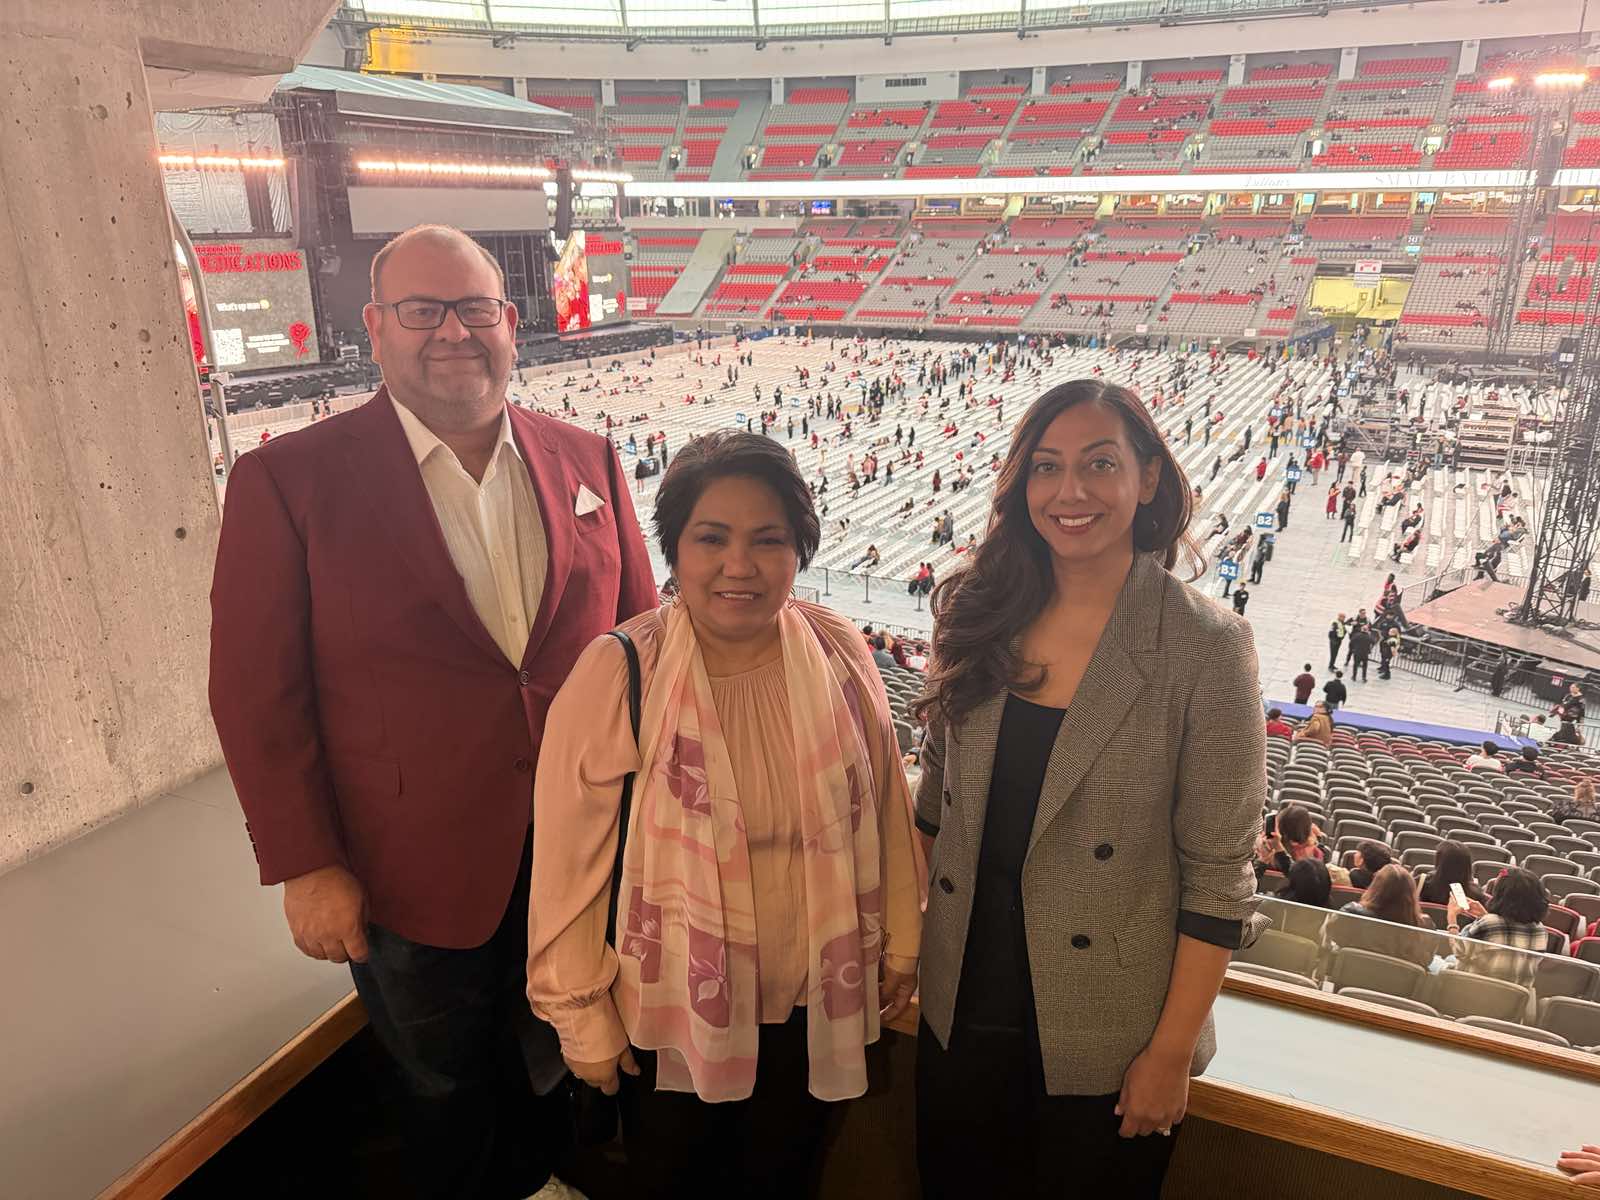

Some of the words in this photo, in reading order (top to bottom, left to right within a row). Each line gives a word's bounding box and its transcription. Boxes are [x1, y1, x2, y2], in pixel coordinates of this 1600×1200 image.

[1287, 470, 1301, 480] 83
[1257, 515, 1273, 525] 82
[1220, 564, 1237, 577] 81
